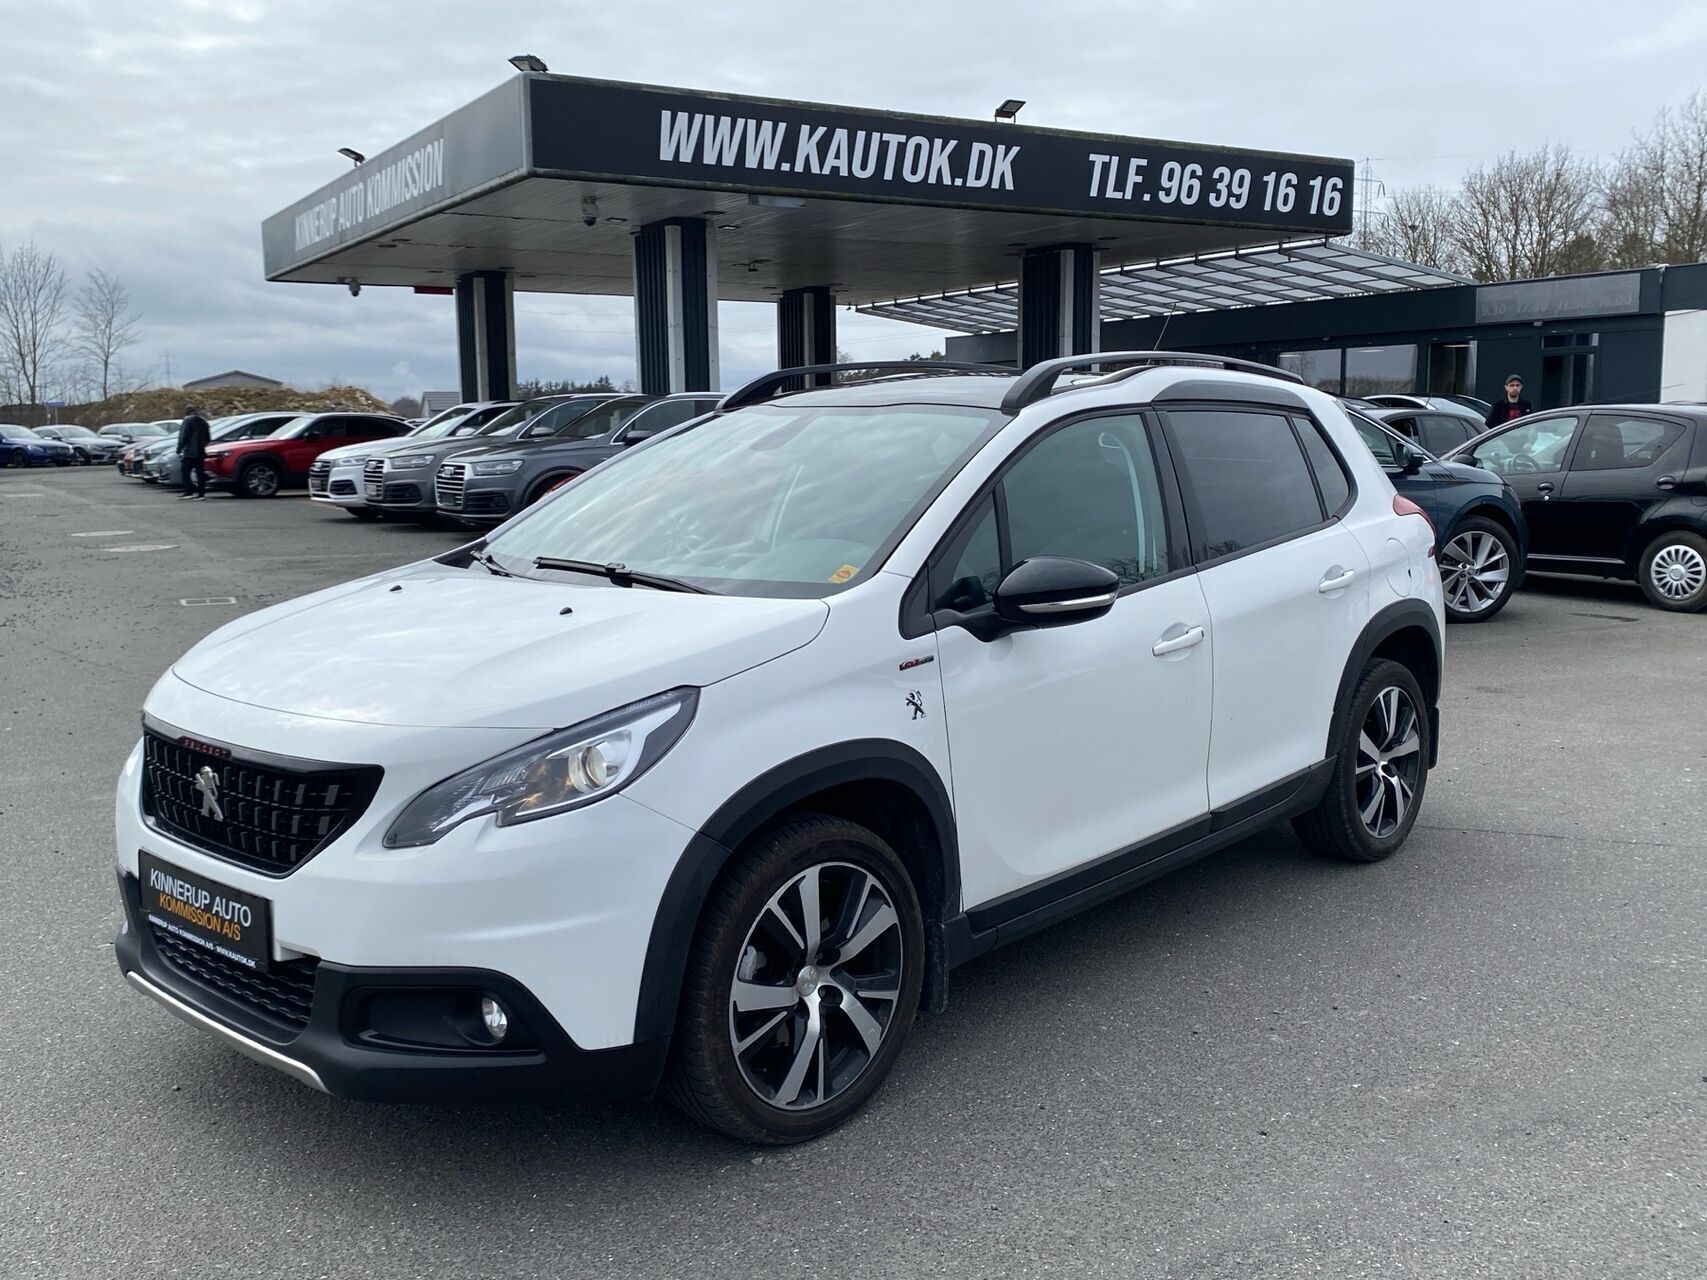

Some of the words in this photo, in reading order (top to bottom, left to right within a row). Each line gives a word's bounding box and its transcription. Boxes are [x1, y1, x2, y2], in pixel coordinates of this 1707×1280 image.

[659, 109, 1021, 191] WWW.KAUTOK.DK
[338, 182, 364, 232] AUTO
[366, 138, 444, 219] KOMMISSION
[1088, 153, 1151, 201] TLF.
[1158, 161, 1203, 205] 96
[1209, 166, 1252, 209] 39
[1262, 171, 1298, 213] 16
[1308, 176, 1344, 216] 16
[150, 868, 210, 908] KINNERUP
[212, 896, 251, 928] AUTO
[159, 893, 221, 933] KOMMISSION
[222, 921, 241, 941] A/S
